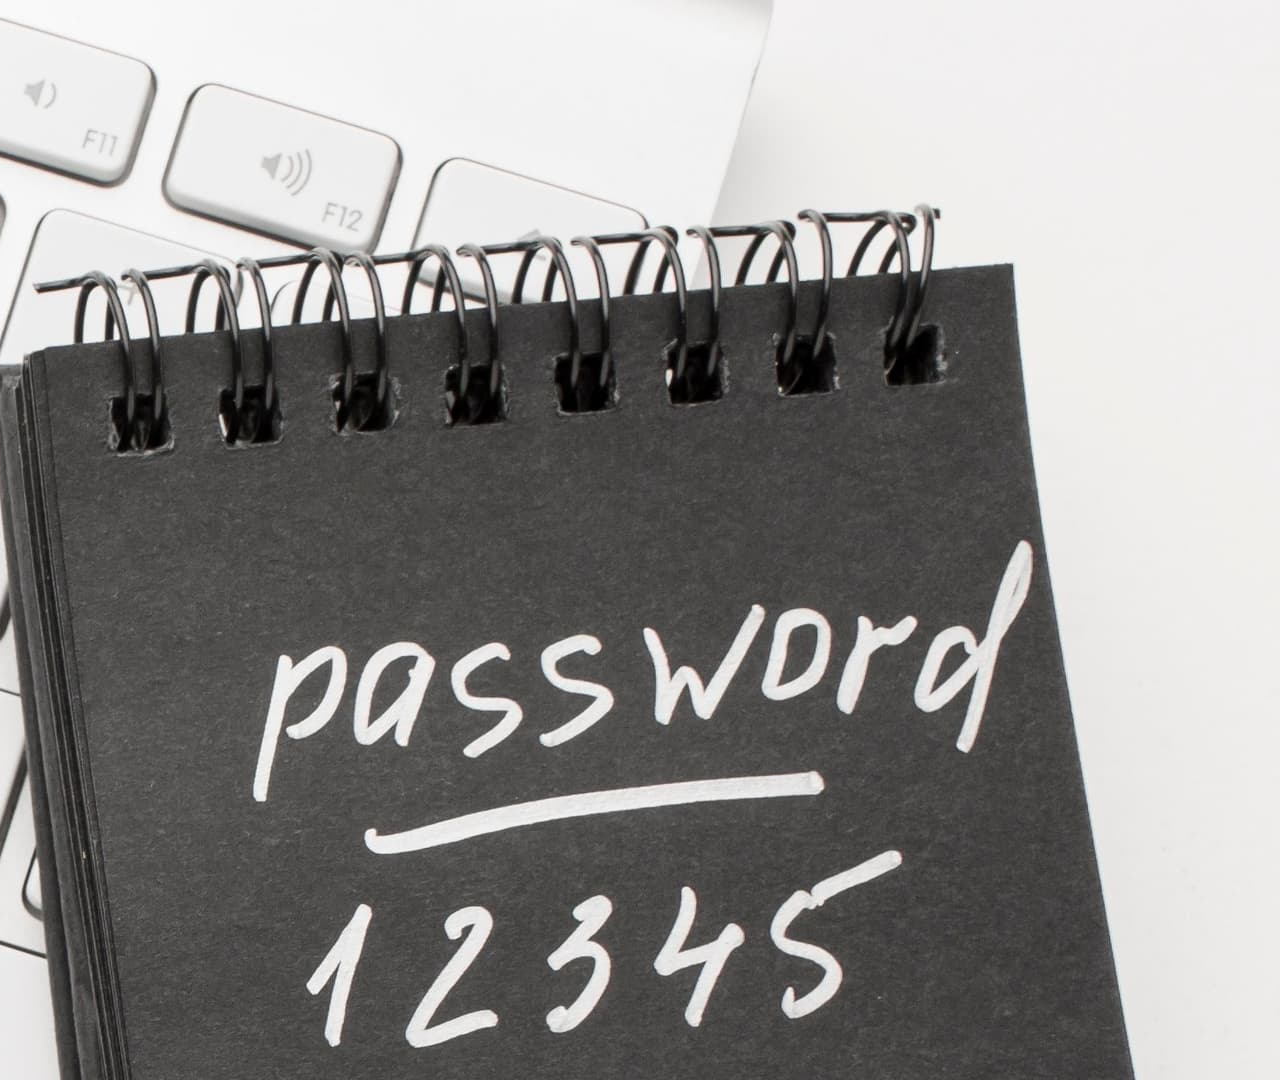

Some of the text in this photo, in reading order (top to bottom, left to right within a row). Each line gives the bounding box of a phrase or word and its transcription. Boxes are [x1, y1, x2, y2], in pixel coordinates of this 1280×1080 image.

[82, 128, 118, 157] F11
[320, 200, 364, 233] F12
[251, 539, 1034, 802] password
[305, 849, 903, 1049] 12345
